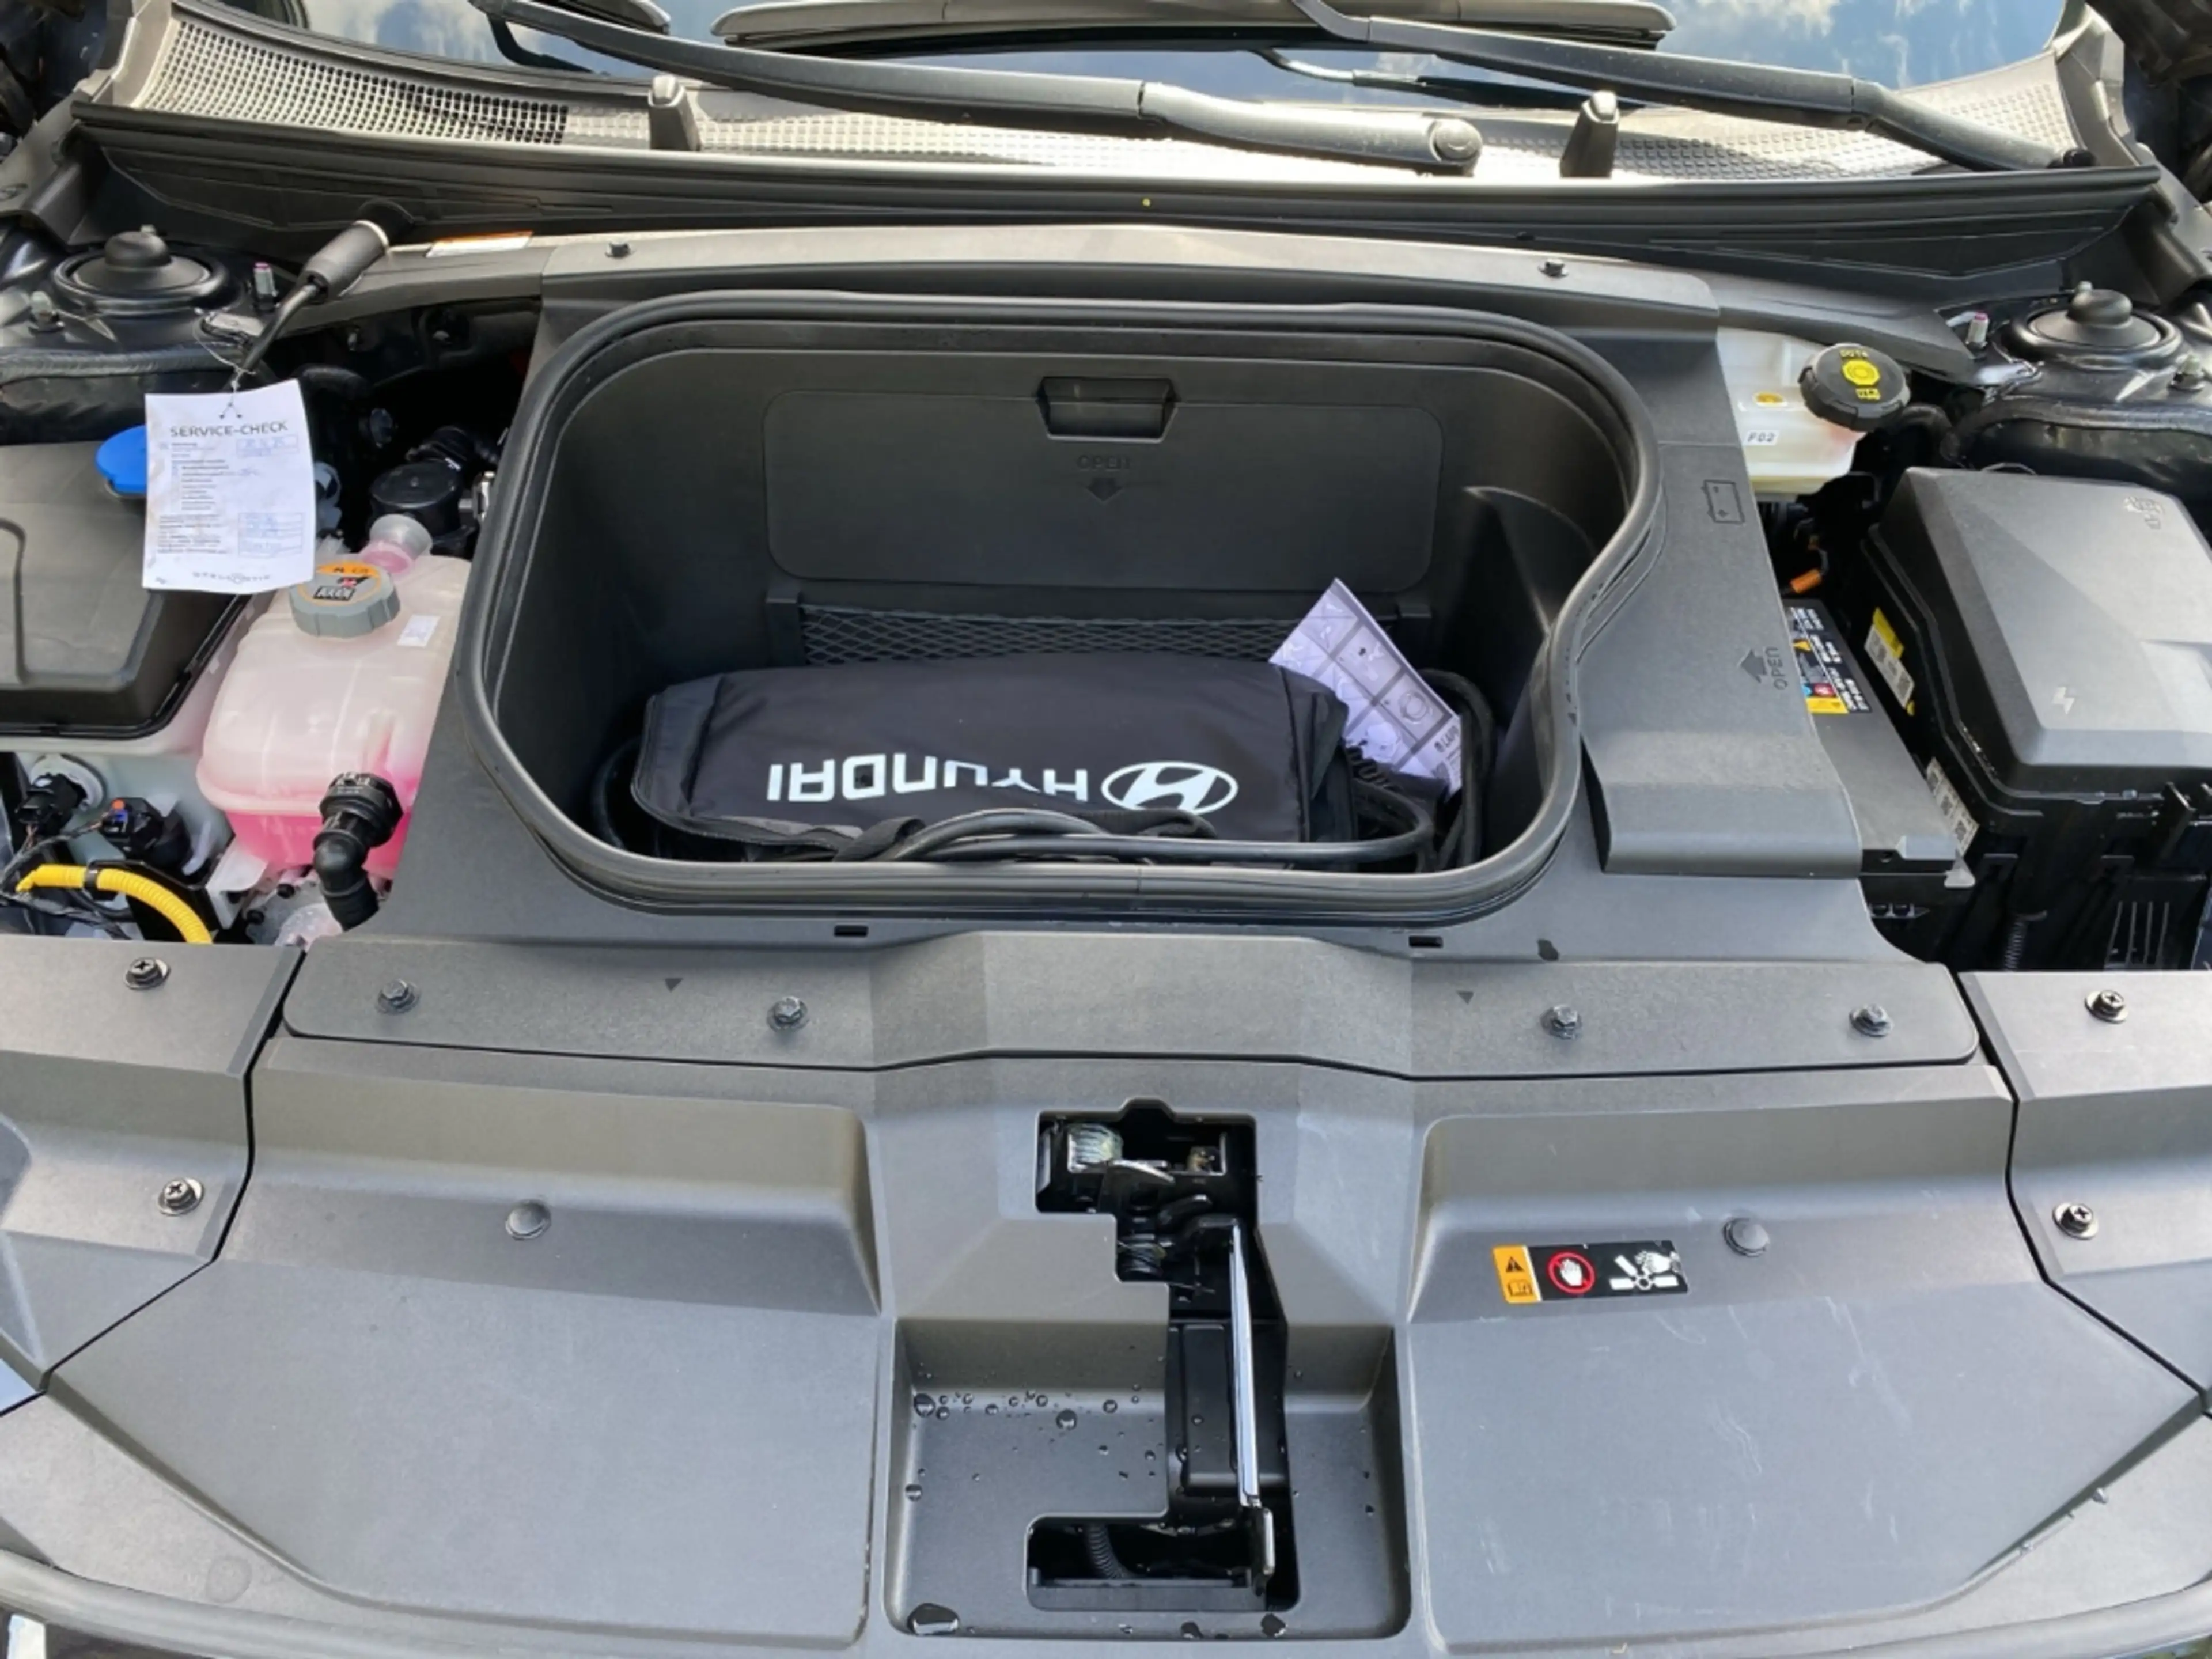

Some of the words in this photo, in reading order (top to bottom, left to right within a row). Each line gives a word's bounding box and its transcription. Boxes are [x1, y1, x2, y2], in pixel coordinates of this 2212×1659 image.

[170, 420, 288, 437] SERVICE-CHECK
[1075, 454, 1131, 471] OPEN
[1764, 647, 1788, 690] OPEN
[767, 753, 1088, 802] HYUNDAI
